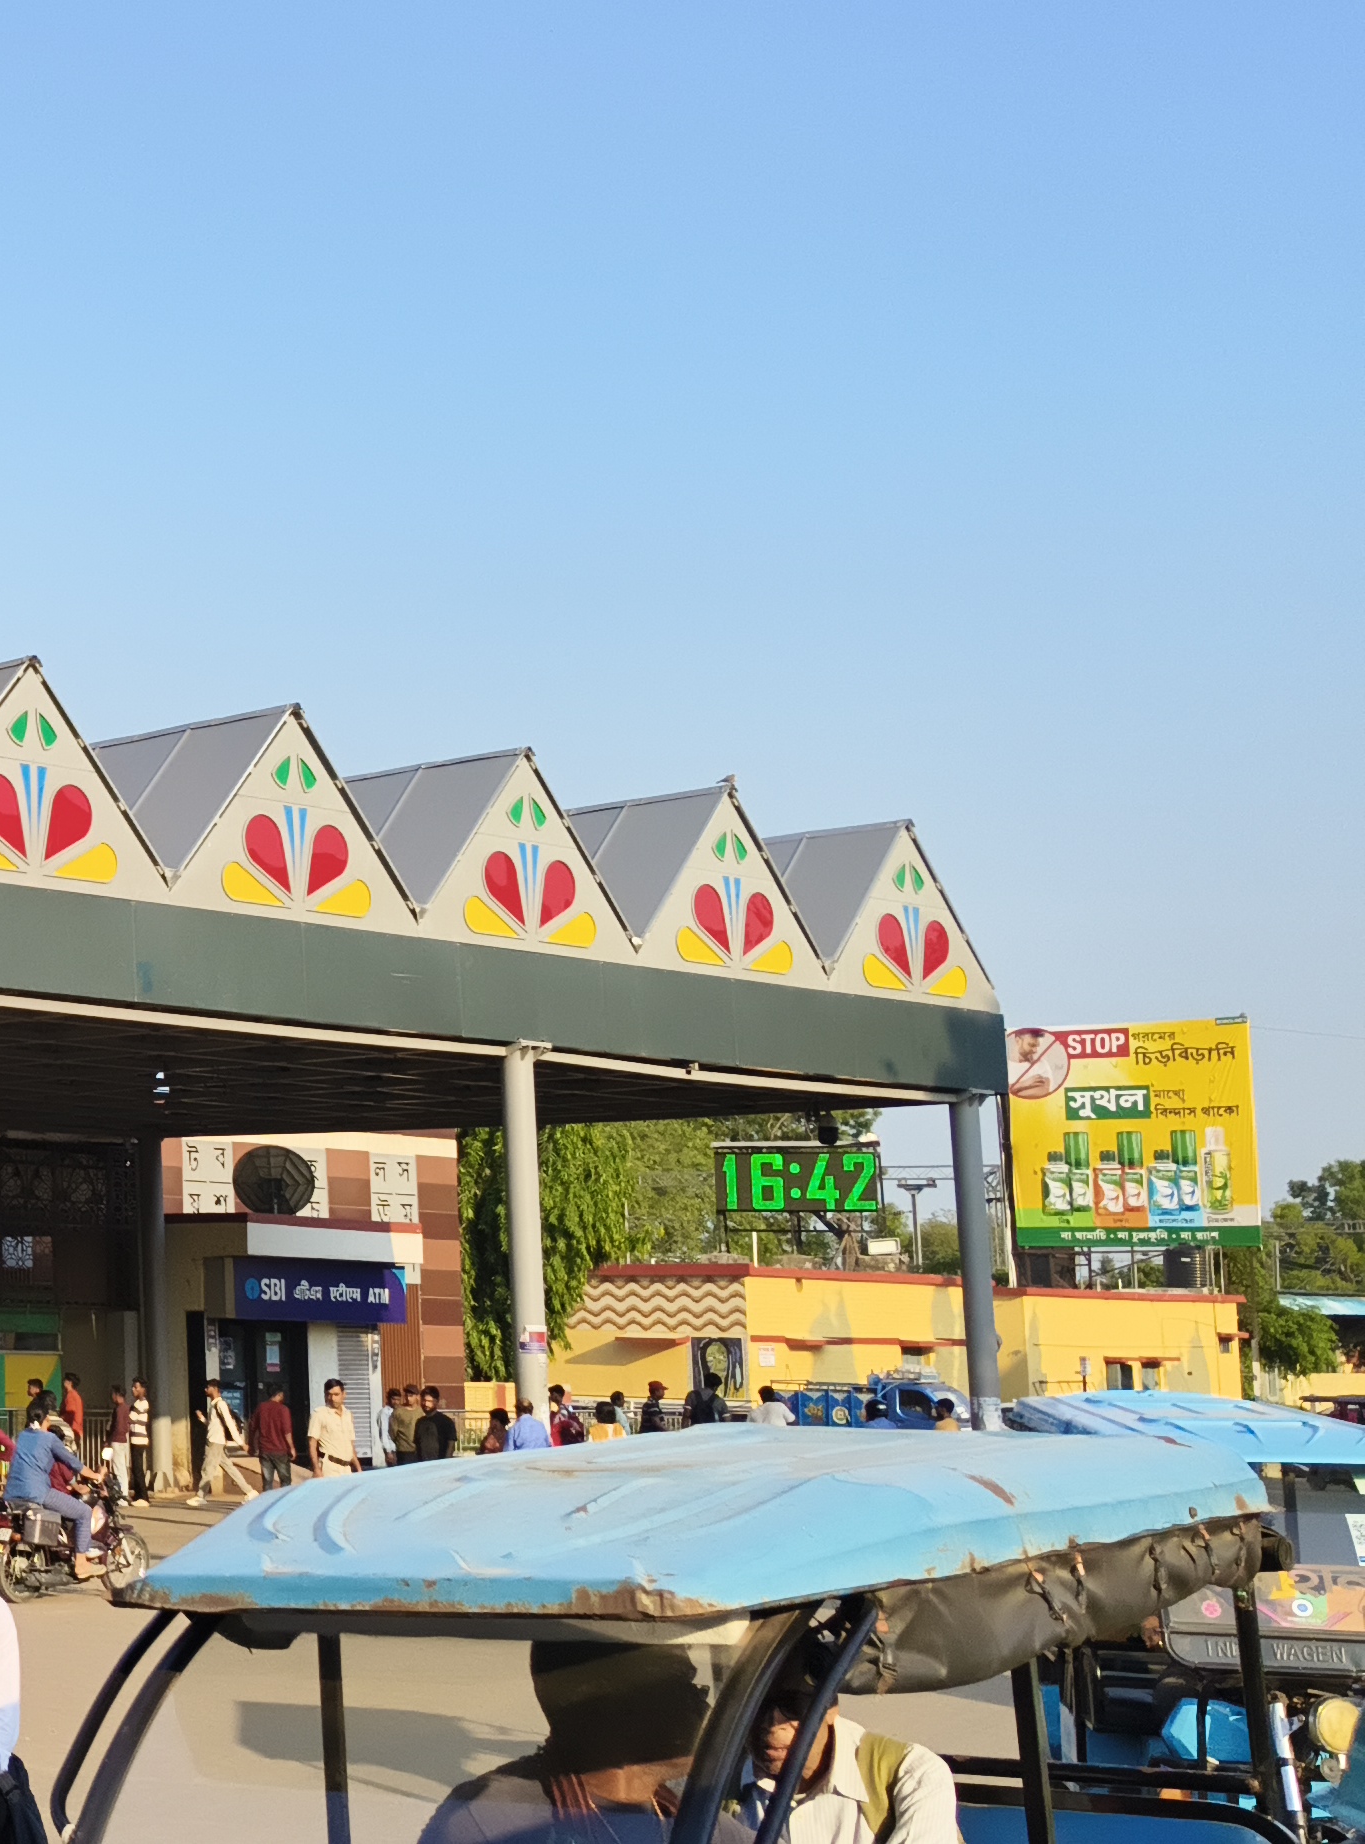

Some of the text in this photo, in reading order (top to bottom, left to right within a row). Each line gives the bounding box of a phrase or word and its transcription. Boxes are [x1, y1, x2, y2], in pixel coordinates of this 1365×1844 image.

[1067, 1032, 1126, 1055] STOP
[1067, 1088, 1147, 1119] সুথল
[373, 1161, 387, 1182] ল
[723, 1153, 879, 1211] 16:42
[261, 1278, 286, 1301] SBI
[367, 1288, 390, 1305] ATM
[1272, 1643, 1347, 1664] WAGEN
